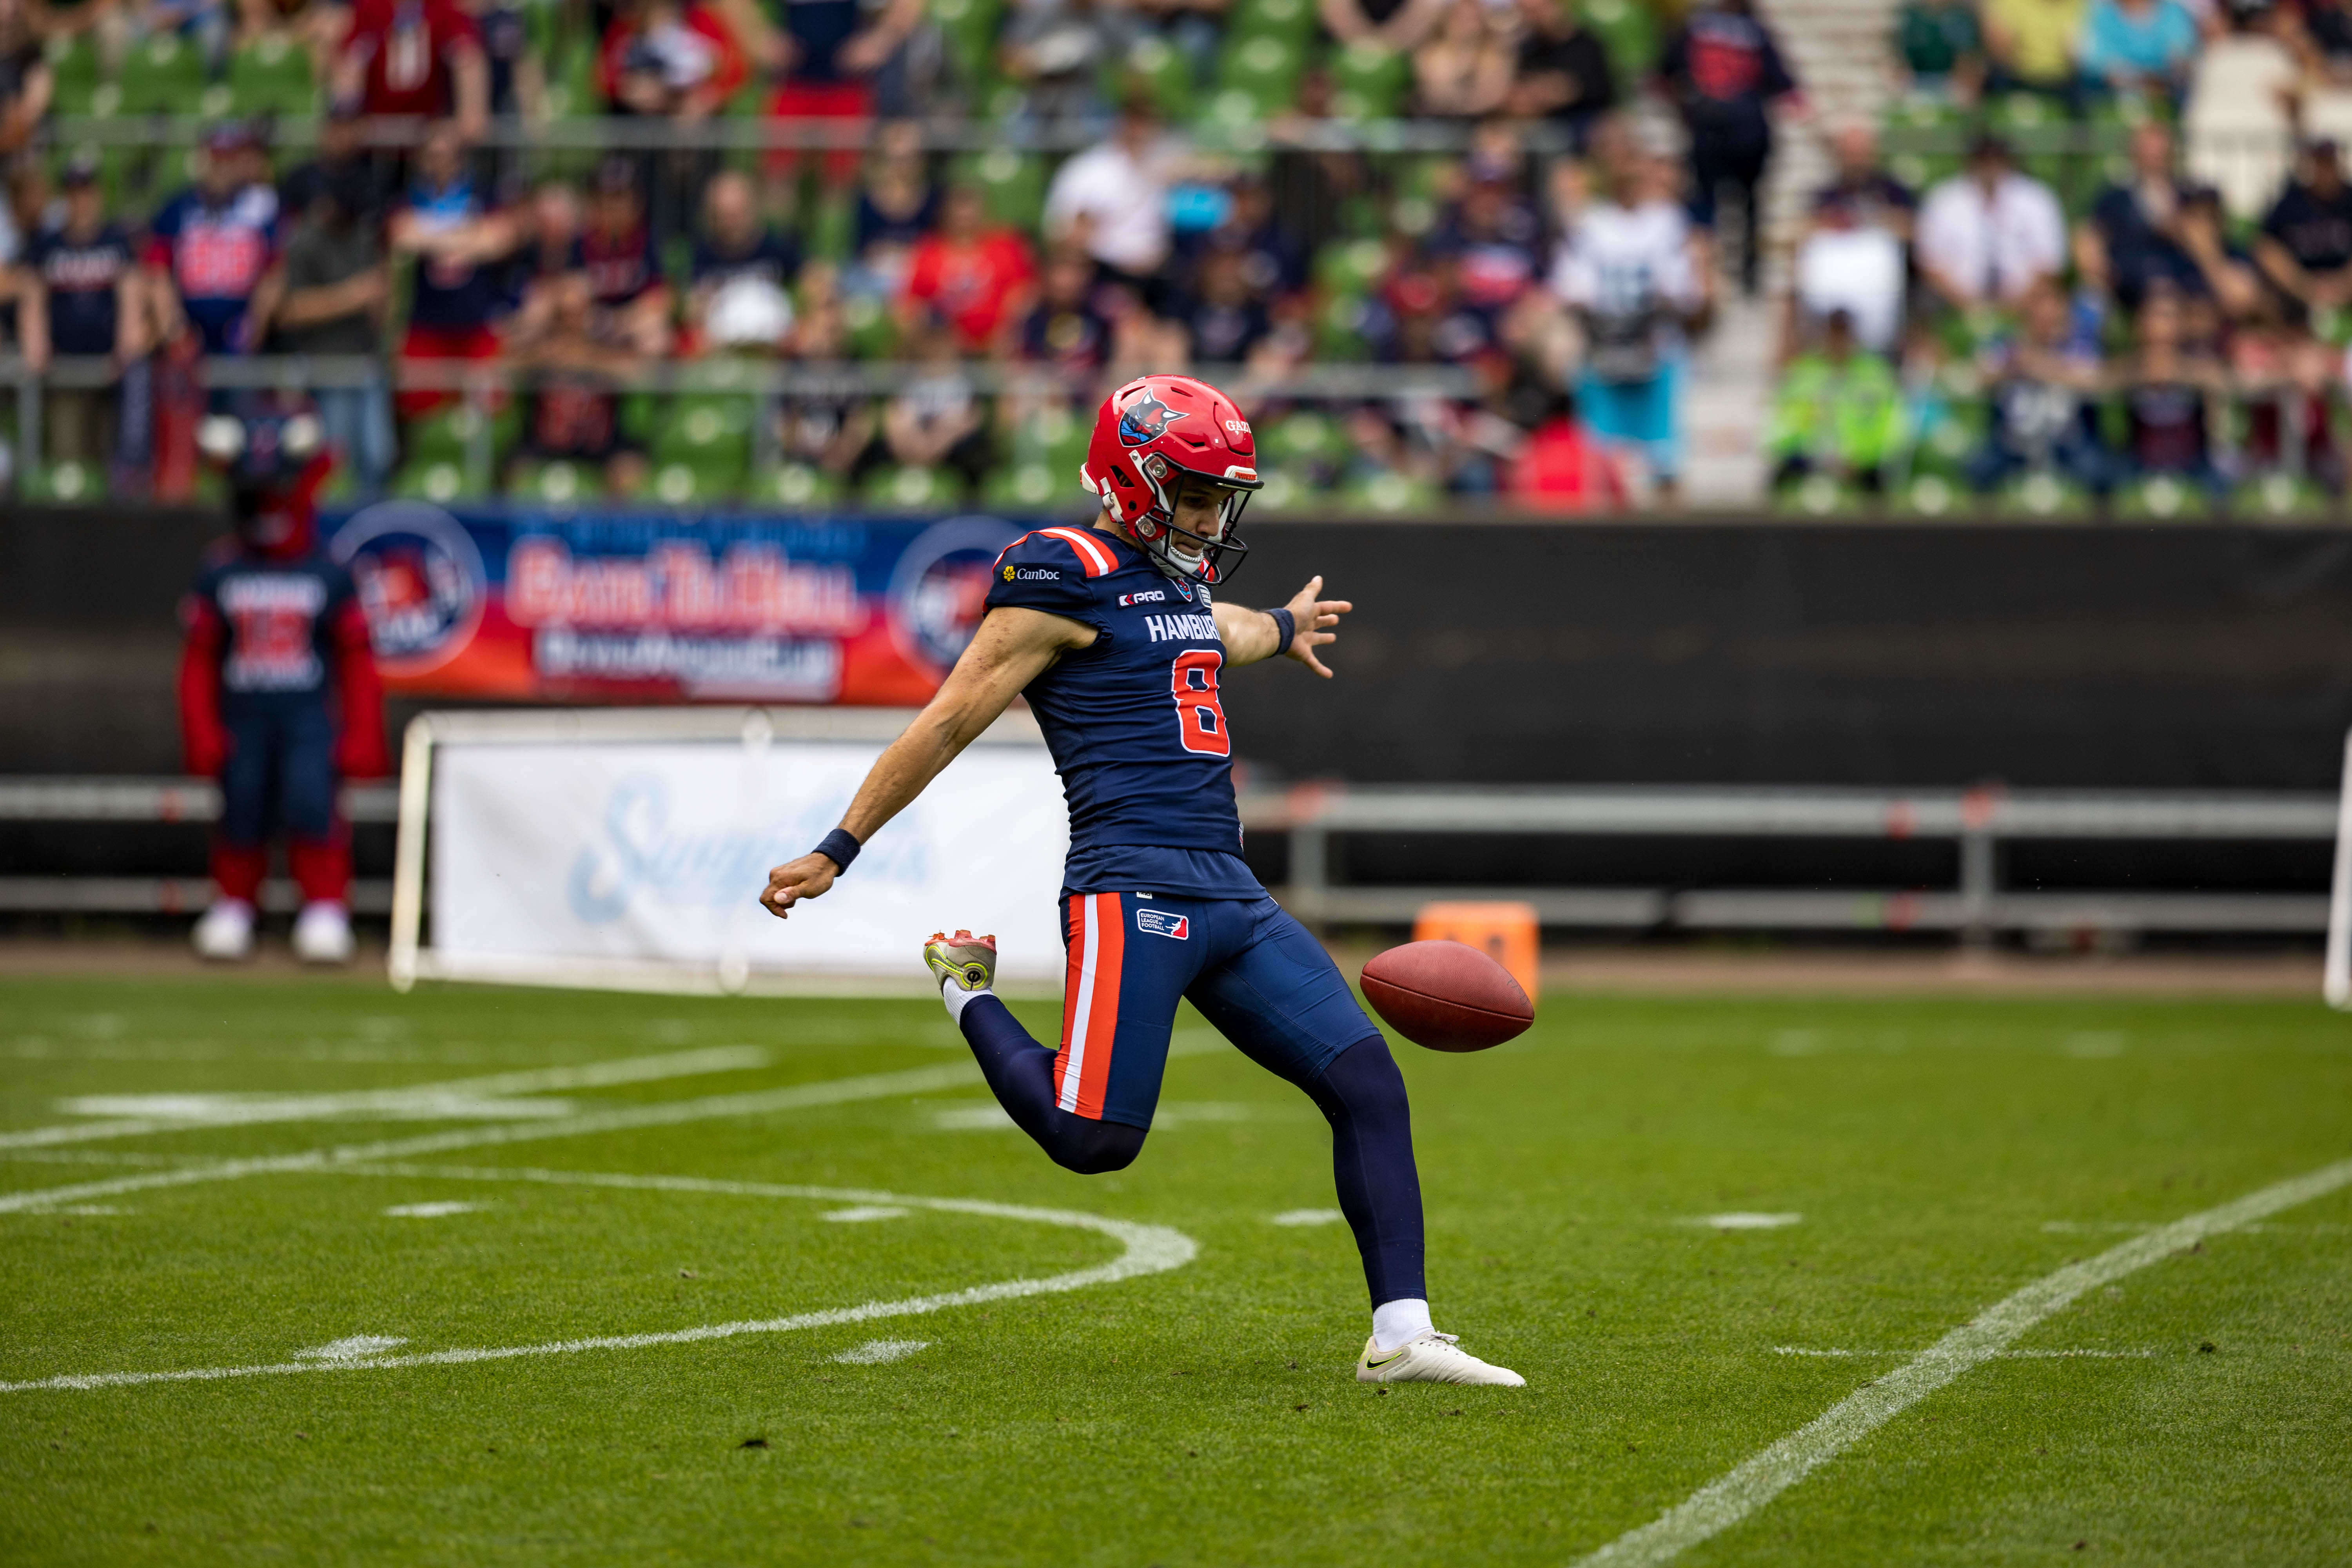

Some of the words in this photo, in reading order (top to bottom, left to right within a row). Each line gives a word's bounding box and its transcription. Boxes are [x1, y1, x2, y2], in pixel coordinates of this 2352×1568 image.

[1017, 568, 1060, 580] CanDoc
[1145, 614, 1221, 642] HAMBUR
[1172, 650, 1230, 757] 8
[1140, 913, 1165, 922] EUROPEAN
[1142, 922, 1165, 931] FOOTBALL
